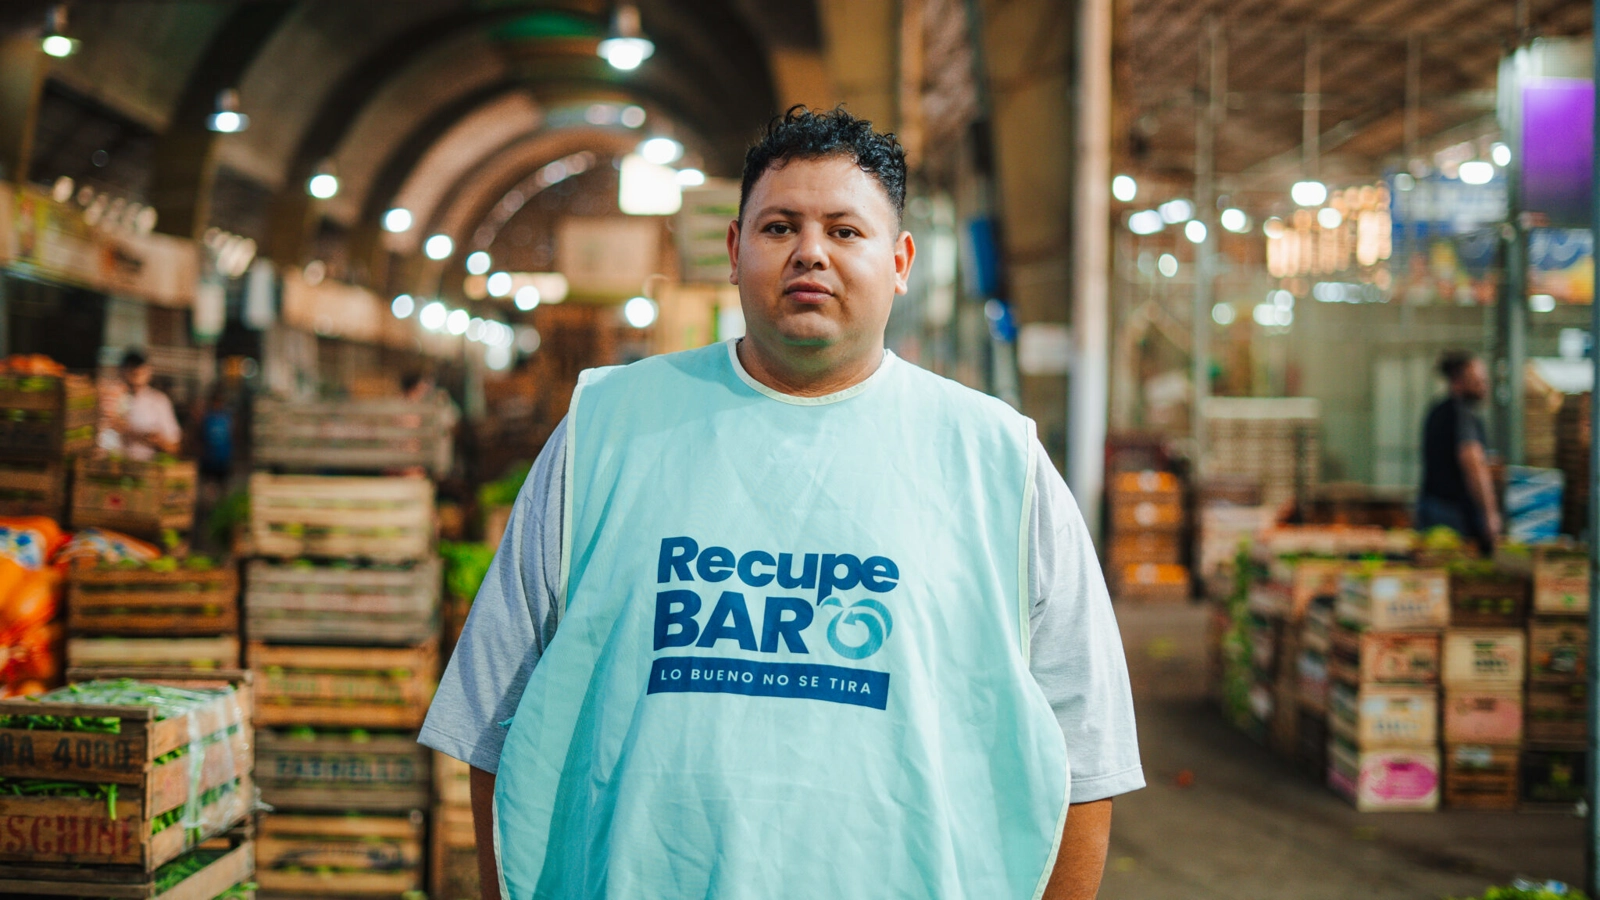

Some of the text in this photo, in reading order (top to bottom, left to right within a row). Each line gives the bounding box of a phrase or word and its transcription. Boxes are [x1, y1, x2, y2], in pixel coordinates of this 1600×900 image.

[657, 536, 899, 606] Recupe
[653, 590, 814, 654] BAR
[661, 669, 871, 694] LO BUENO NO SE TIRA
